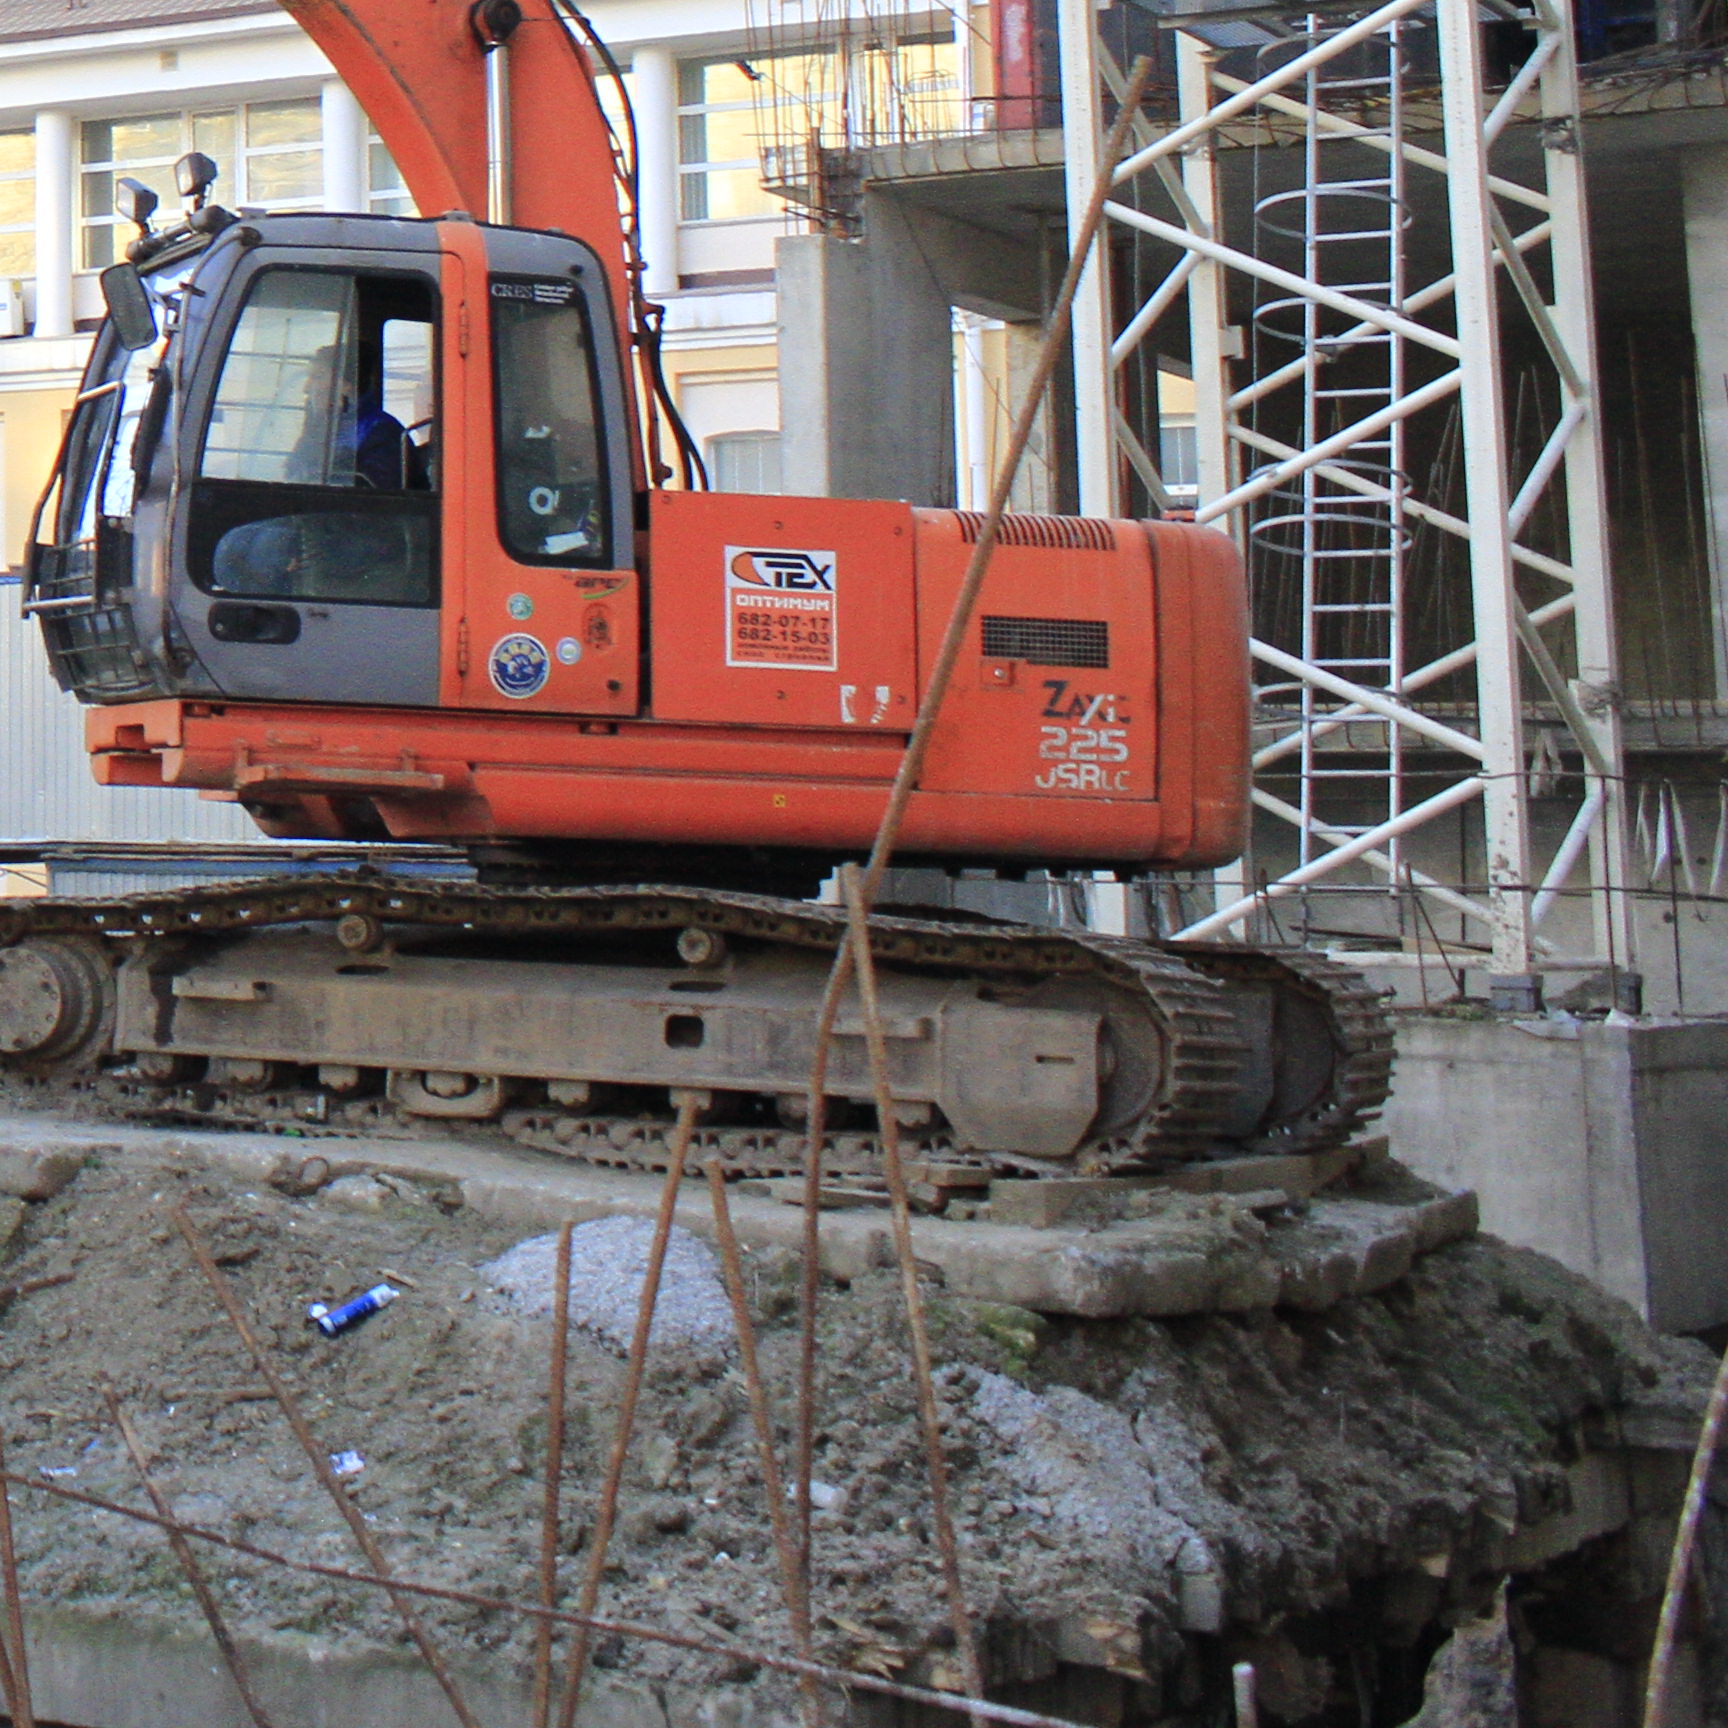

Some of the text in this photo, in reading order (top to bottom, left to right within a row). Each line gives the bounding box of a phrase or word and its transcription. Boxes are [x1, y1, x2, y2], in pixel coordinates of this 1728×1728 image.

[735, 593, 831, 611] ОПТИМУМ
[737, 612, 831, 630] 682-07-17
[737, 627, 831, 645] 682-15-03
[1039, 725, 1129, 763] 225
